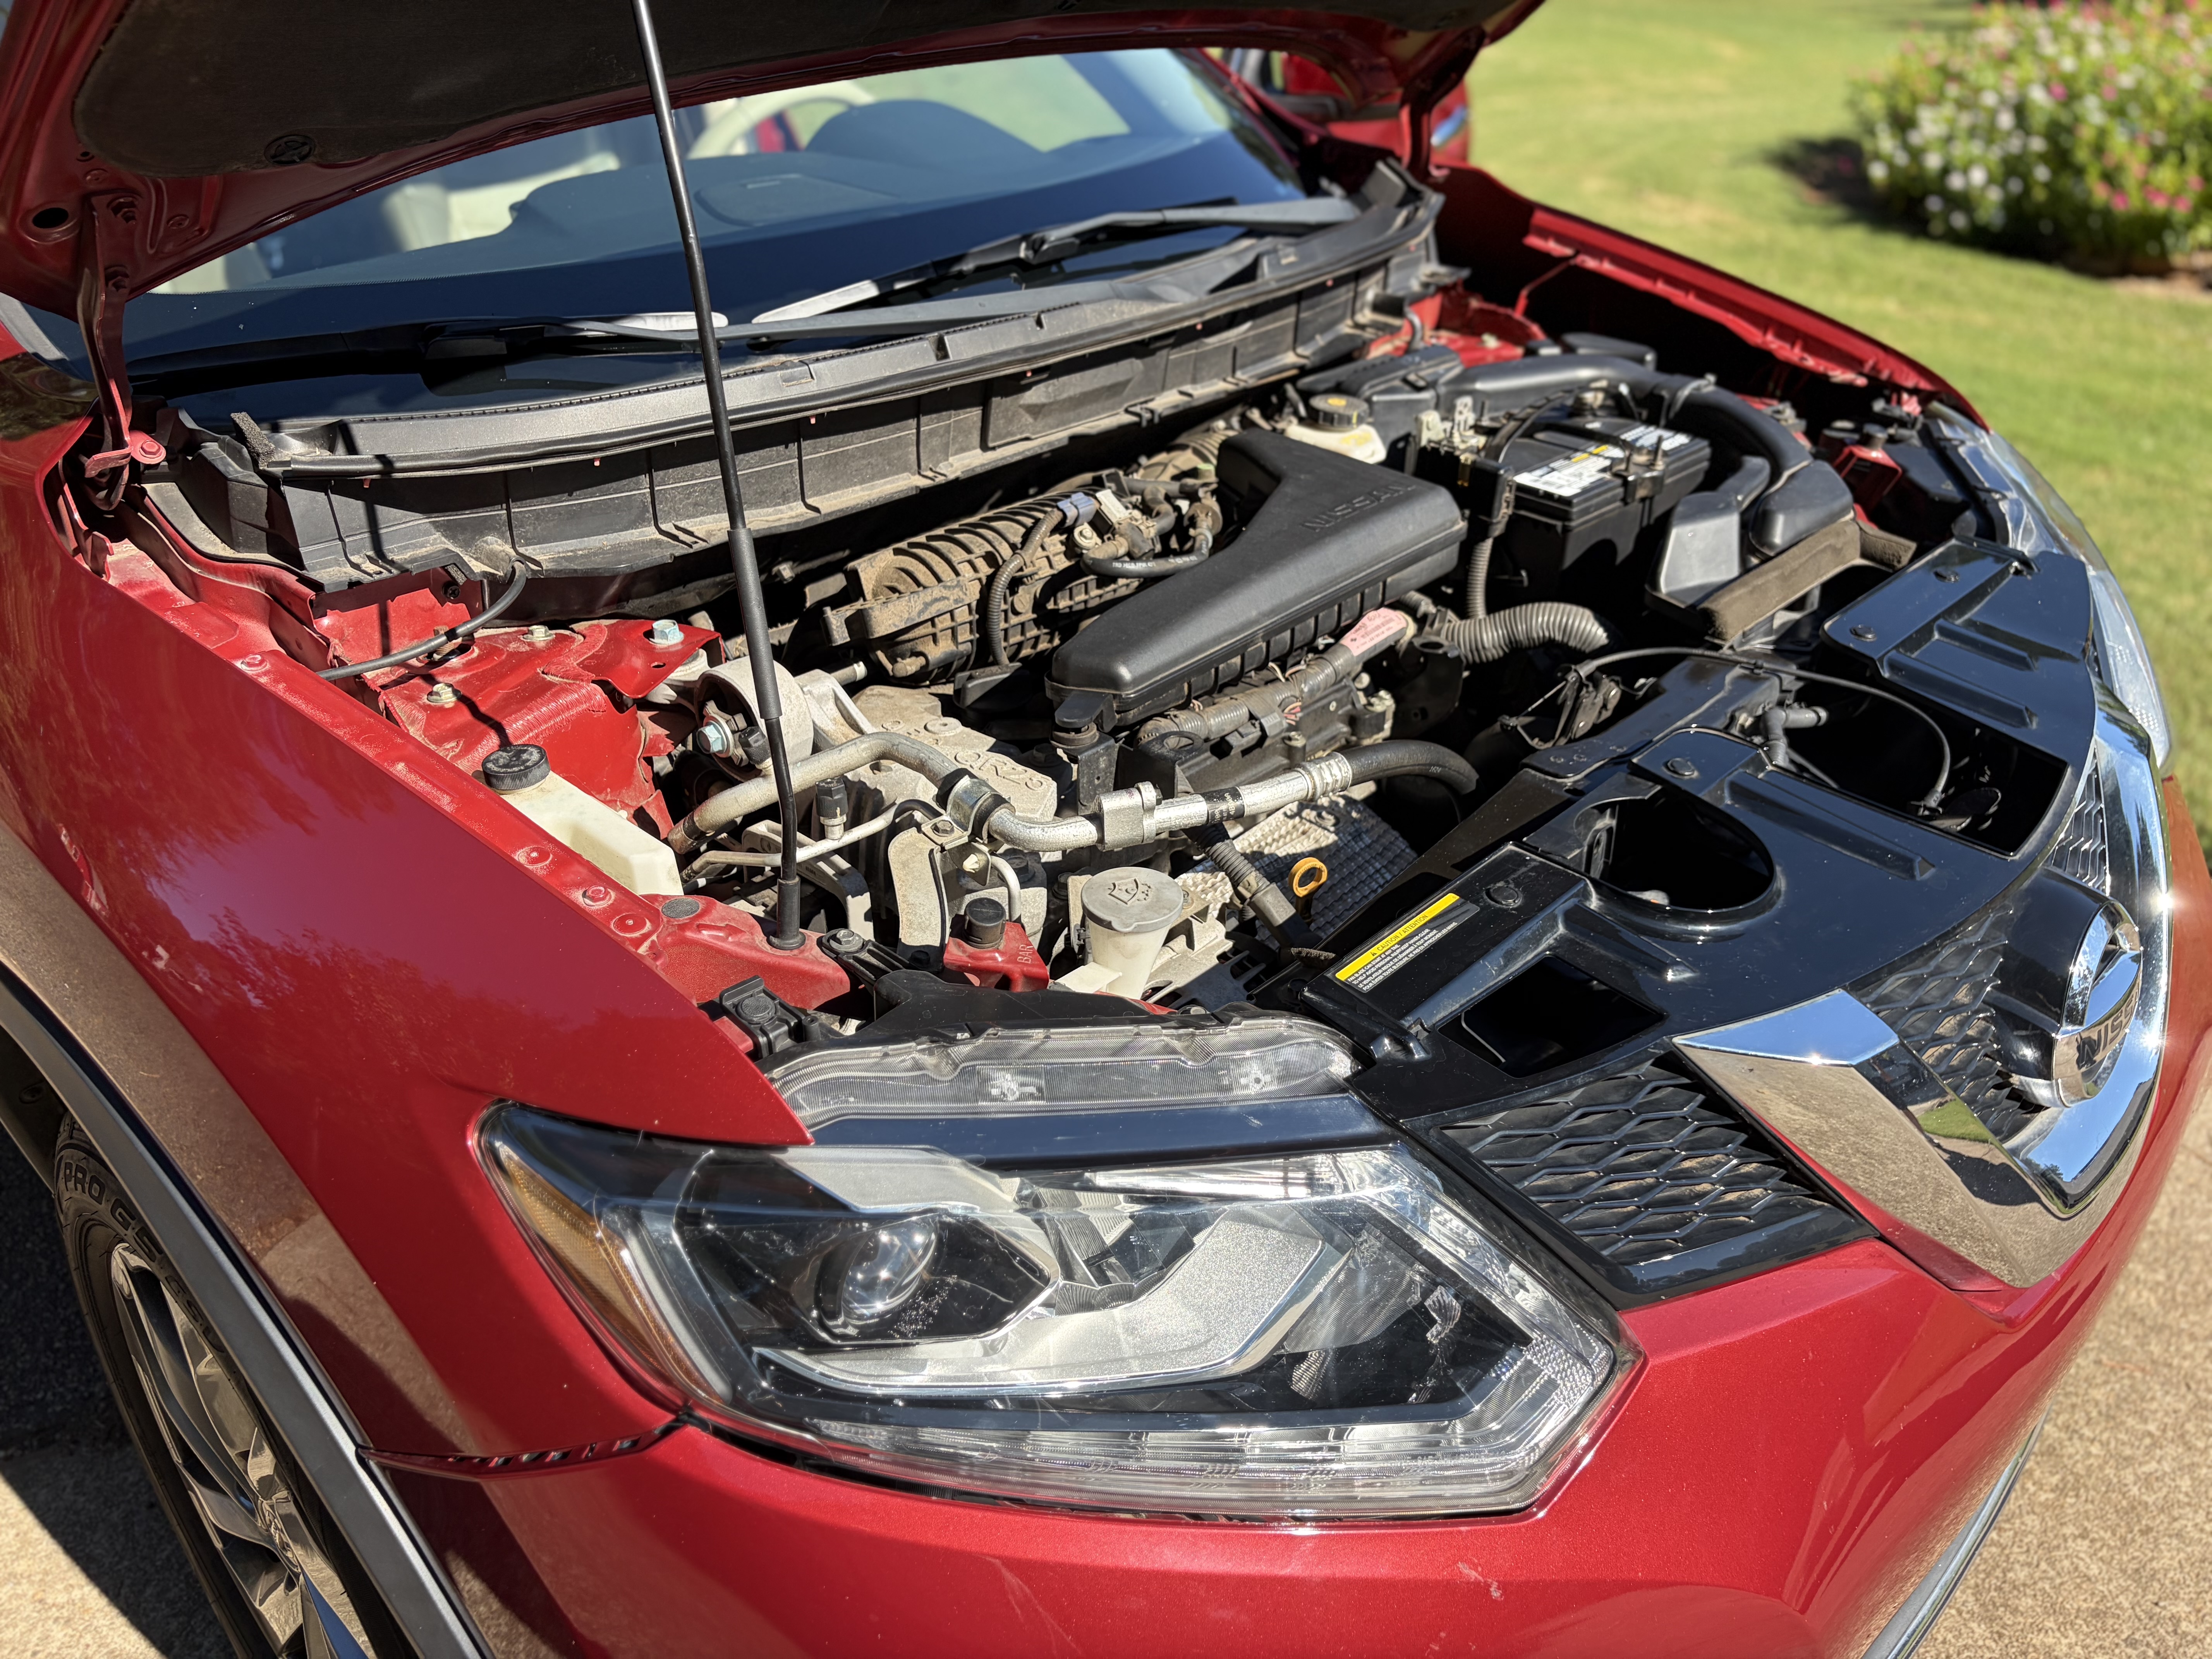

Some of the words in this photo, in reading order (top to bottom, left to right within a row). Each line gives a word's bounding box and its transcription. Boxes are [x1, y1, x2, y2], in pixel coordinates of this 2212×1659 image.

[1300, 485, 1417, 532] NISSAN
[1377, 935, 1400, 951] CAUTION
[1402, 915, 1428, 933] ATTENTION
[1017, 945, 1033, 963] BAR
[1354, 968, 1366, 977] BLADE
[1371, 957, 1382, 965] START
[1362, 982, 1374, 991] POUR
[1382, 967, 1394, 976] TOUTE
[1423, 932, 1443, 946] APPROCHER
[1362, 969, 1383, 984] VENTILATEUR
[1381, 961, 1395, 970] RISQUE
[1396, 945, 1415, 959] DÉMARRER
[1365, 967, 1376, 975] AVOID
[1374, 955, 1392, 968] PERSONAL
[1408, 935, 1420, 944] HANDS
[2078, 982, 2139, 1070] NISS
[64, 1161, 106, 1205] PRO
